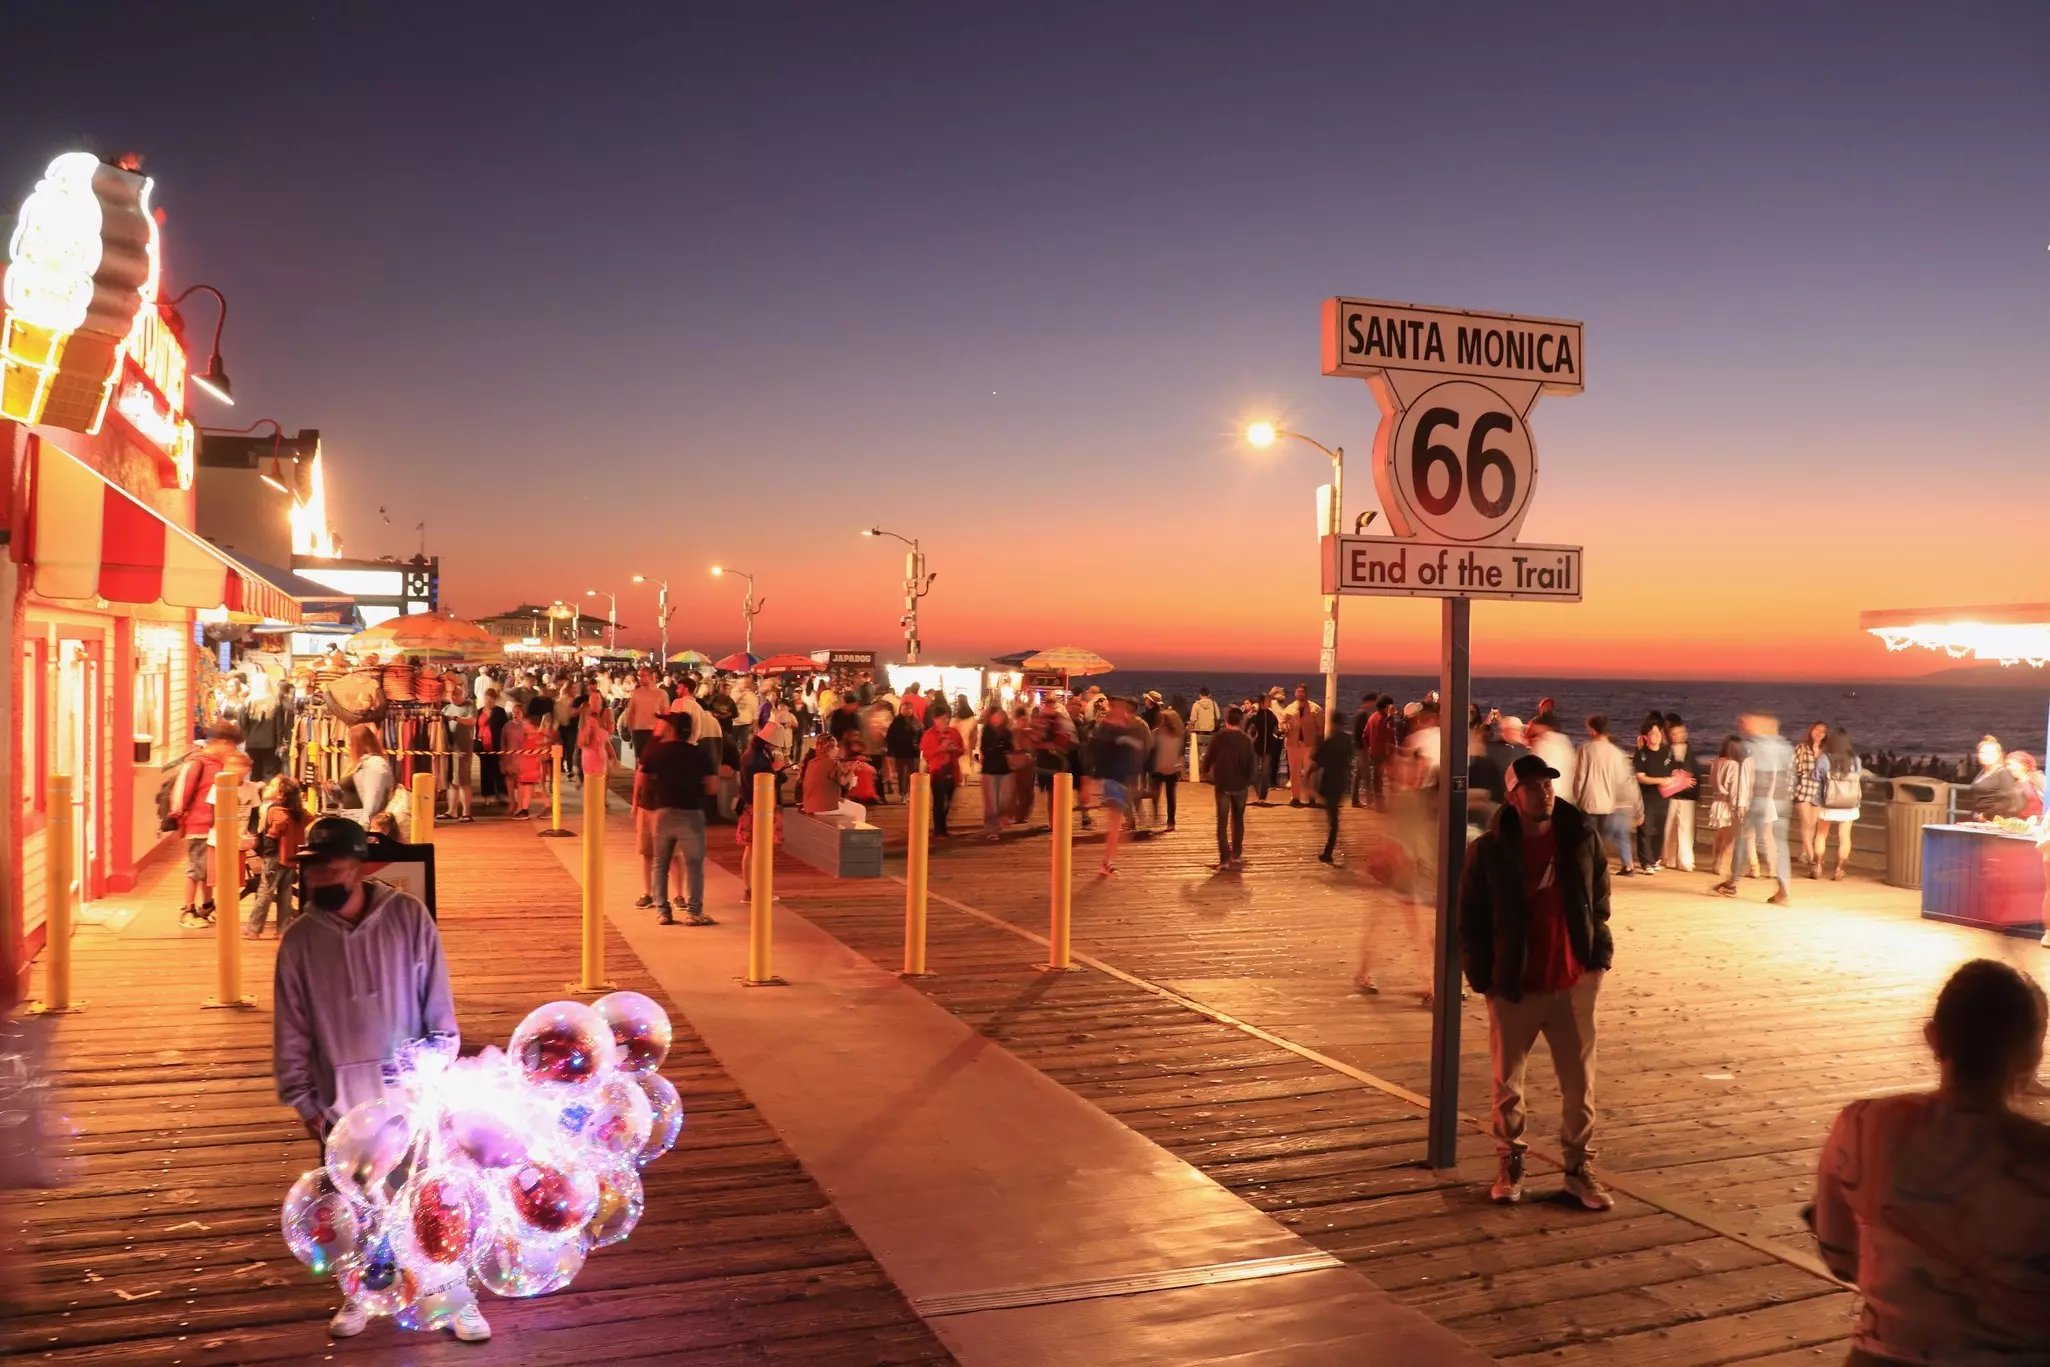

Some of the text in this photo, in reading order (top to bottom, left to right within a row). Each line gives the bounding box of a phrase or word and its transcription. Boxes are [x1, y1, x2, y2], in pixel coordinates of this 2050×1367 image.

[1348, 313, 1574, 374] SANTA MONICA
[1411, 407, 1516, 519] 66
[1351, 548, 1571, 589] End of the Trail
